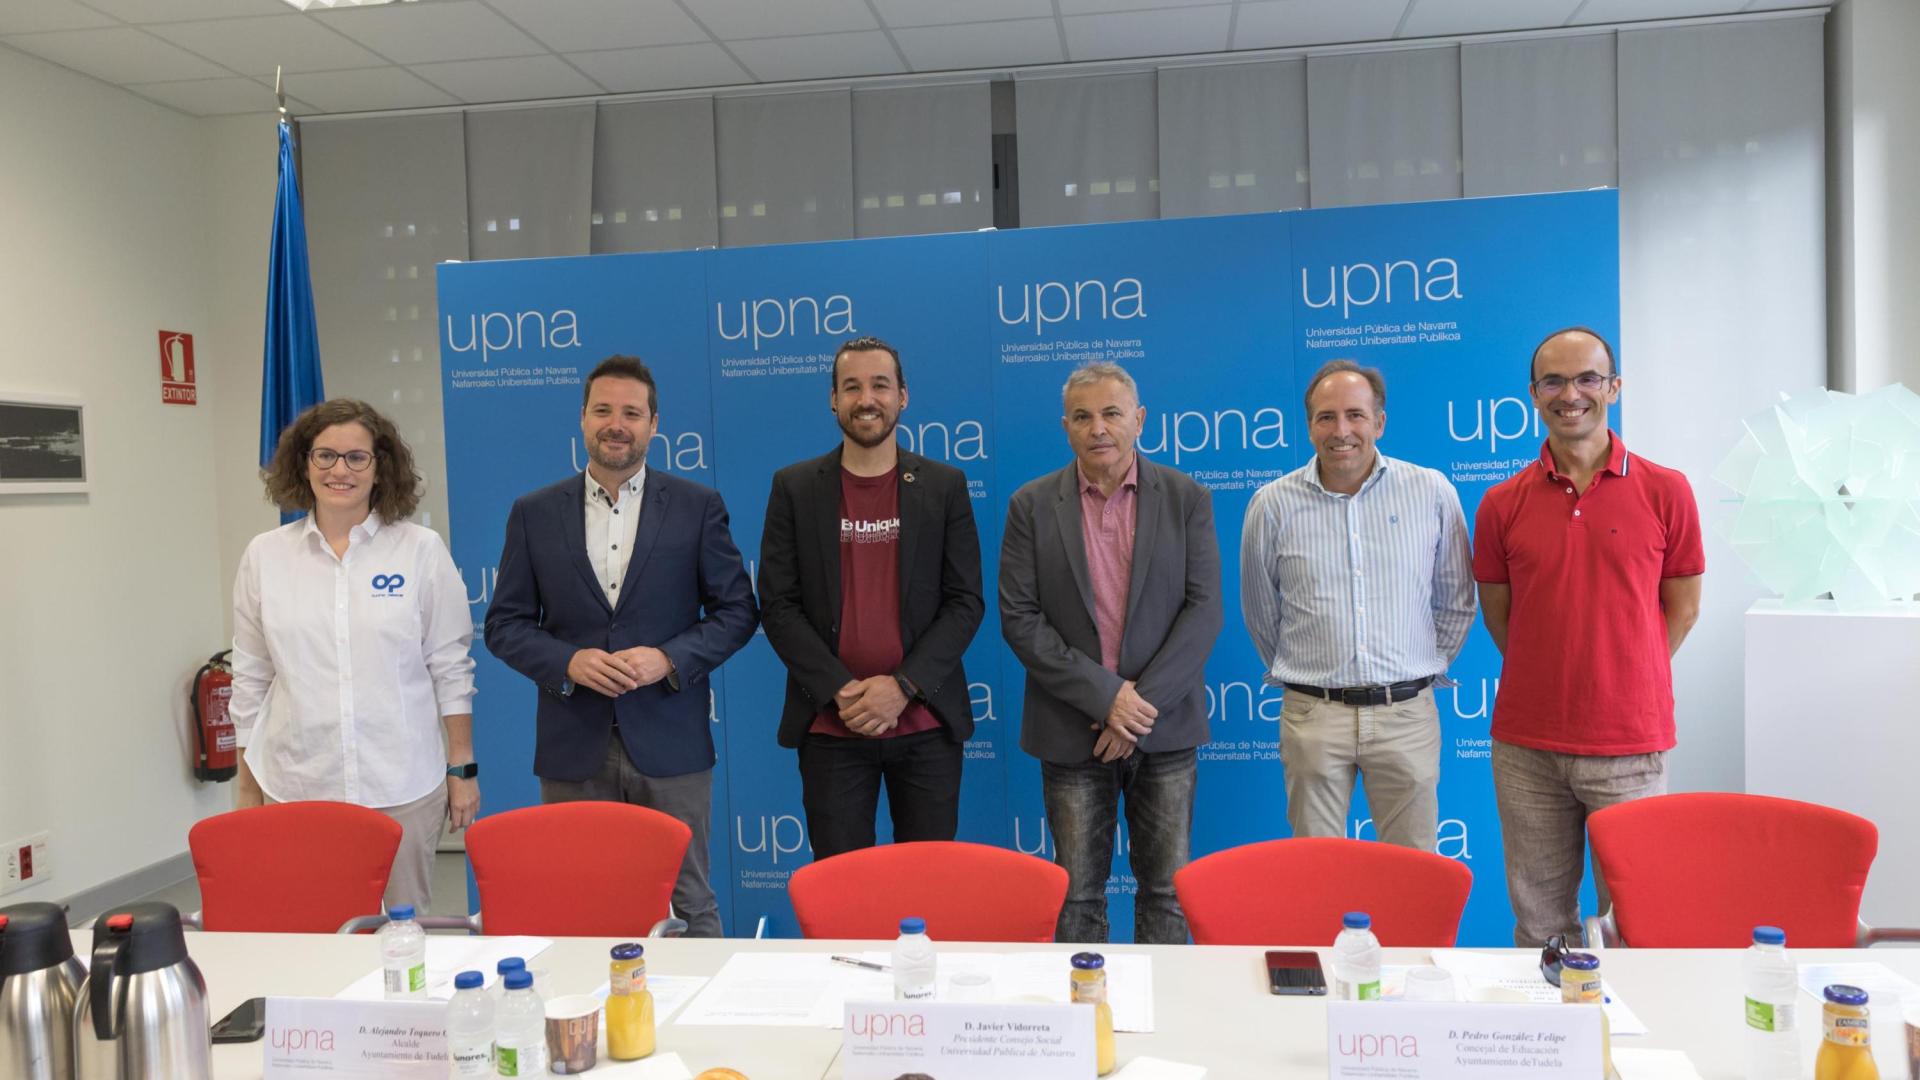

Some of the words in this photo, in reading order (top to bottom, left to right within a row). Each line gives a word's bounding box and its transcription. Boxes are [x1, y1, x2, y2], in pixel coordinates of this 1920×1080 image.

[1302, 258, 1463, 319] upna
[998, 278, 1147, 336] upna
[717, 295, 857, 351] upna
[1305, 326, 1362, 337] Universidad
[1364, 323, 1400, 334] Pública
[1403, 322, 1416, 332] de
[1418, 321, 1457, 331] Navarra
[447, 309, 582, 363] upna
[1306, 338, 1358, 349] Nafarroako
[1419, 332, 1461, 342] Publikoa
[1001, 342, 1053, 353] Universidad
[1056, 339, 1088, 350] Pública
[1092, 339, 1103, 348] de
[1106, 338, 1142, 348] Navarra
[721, 357, 770, 368] Universidad
[772, 355, 803, 365] Pública
[805, 354, 817, 363] de
[1001, 353, 1050, 364] Nafarroako
[1106, 349, 1145, 359] Publikoa
[451, 368, 498, 379] Universidad
[500, 366, 531, 377] Pública
[533, 366, 543, 375] de
[545, 365, 578, 375] Navarra
[722, 367, 767, 378] Nafarroako
[452, 379, 496, 389] Nafarroako
[546, 376, 580, 386] Publikoa
[163, 387, 195, 401] EXTINTOR
[1451, 460, 1509, 471] Universidad
[1195, 470, 1229, 480] Pública
[1232, 469, 1243, 478] de
[1246, 468, 1282, 478] Navarra
[1451, 472, 1505, 482] Nafarroako
[1238, 740, 1250, 750] de
[1456, 749, 1492, 759] Nafarro
[741, 870, 789, 880] Universidad
[741, 880, 786, 889] Nafarroako
[358, 1026, 367, 1035] D.
[371, 1026, 407, 1037] Alejandro
[409, 1027, 441, 1038] Toquero
[851, 1013, 927, 1042] upna
[964, 1022, 974, 1031] D.
[977, 1022, 1004, 1031] Javier
[1006, 1022, 1050, 1032] Vidorreta
[271, 1027, 335, 1055] upna
[953, 1033, 997, 1043] Presidente
[999, 1034, 1034, 1046] Consejo
[1035, 1035, 1063, 1045] Social
[1448, 1030, 1458, 1040] D.
[1462, 1030, 1489, 1040] Pedro
[1492, 1031, 1535, 1041] González
[1537, 1032, 1567, 1044] Felipe
[391, 1039, 420, 1049] Alcalde
[1338, 1033, 1420, 1064] upna
[1456, 1043, 1496, 1054] Concejal
[1498, 1044, 1509, 1054] de
[1511, 1044, 1559, 1055] Educación
[360, 1049, 413, 1061] Ayuntamiento
[414, 1051, 423, 1060] de
[940, 1046, 991, 1056] Universidad
[993, 1046, 1026, 1056] Pública
[1027, 1047, 1038, 1057] de
[1039, 1048, 1076, 1058] Navarra
[1454, 1056, 1518, 1067] Ayuntamiento
